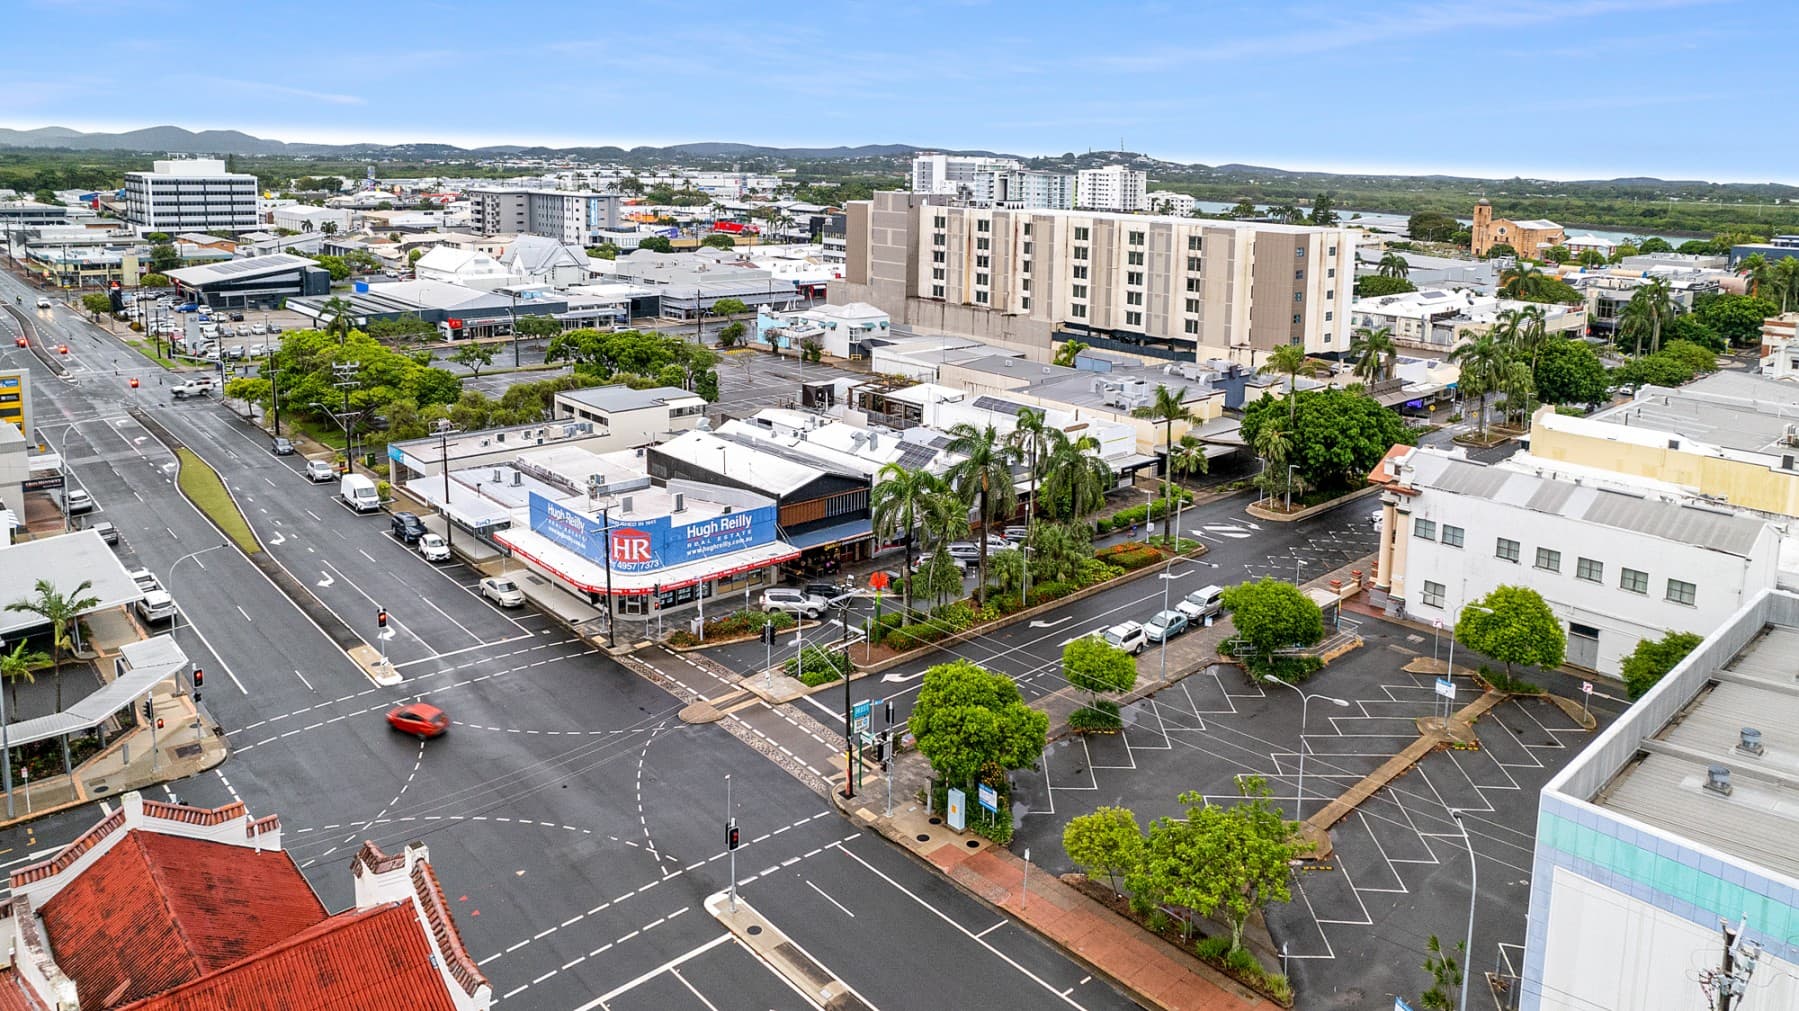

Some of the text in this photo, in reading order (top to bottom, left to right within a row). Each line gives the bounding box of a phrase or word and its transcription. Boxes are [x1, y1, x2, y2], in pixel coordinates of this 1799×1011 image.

[547, 503, 565, 521] Hugh
[565, 512, 585, 534] Reilly
[687, 514, 752, 538] Hugh Reilly
[613, 537, 652, 560] HR
[687, 529, 752, 549] REAL ESTATE
[617, 561, 637, 570] 4957
[640, 559, 660, 570] 7373
